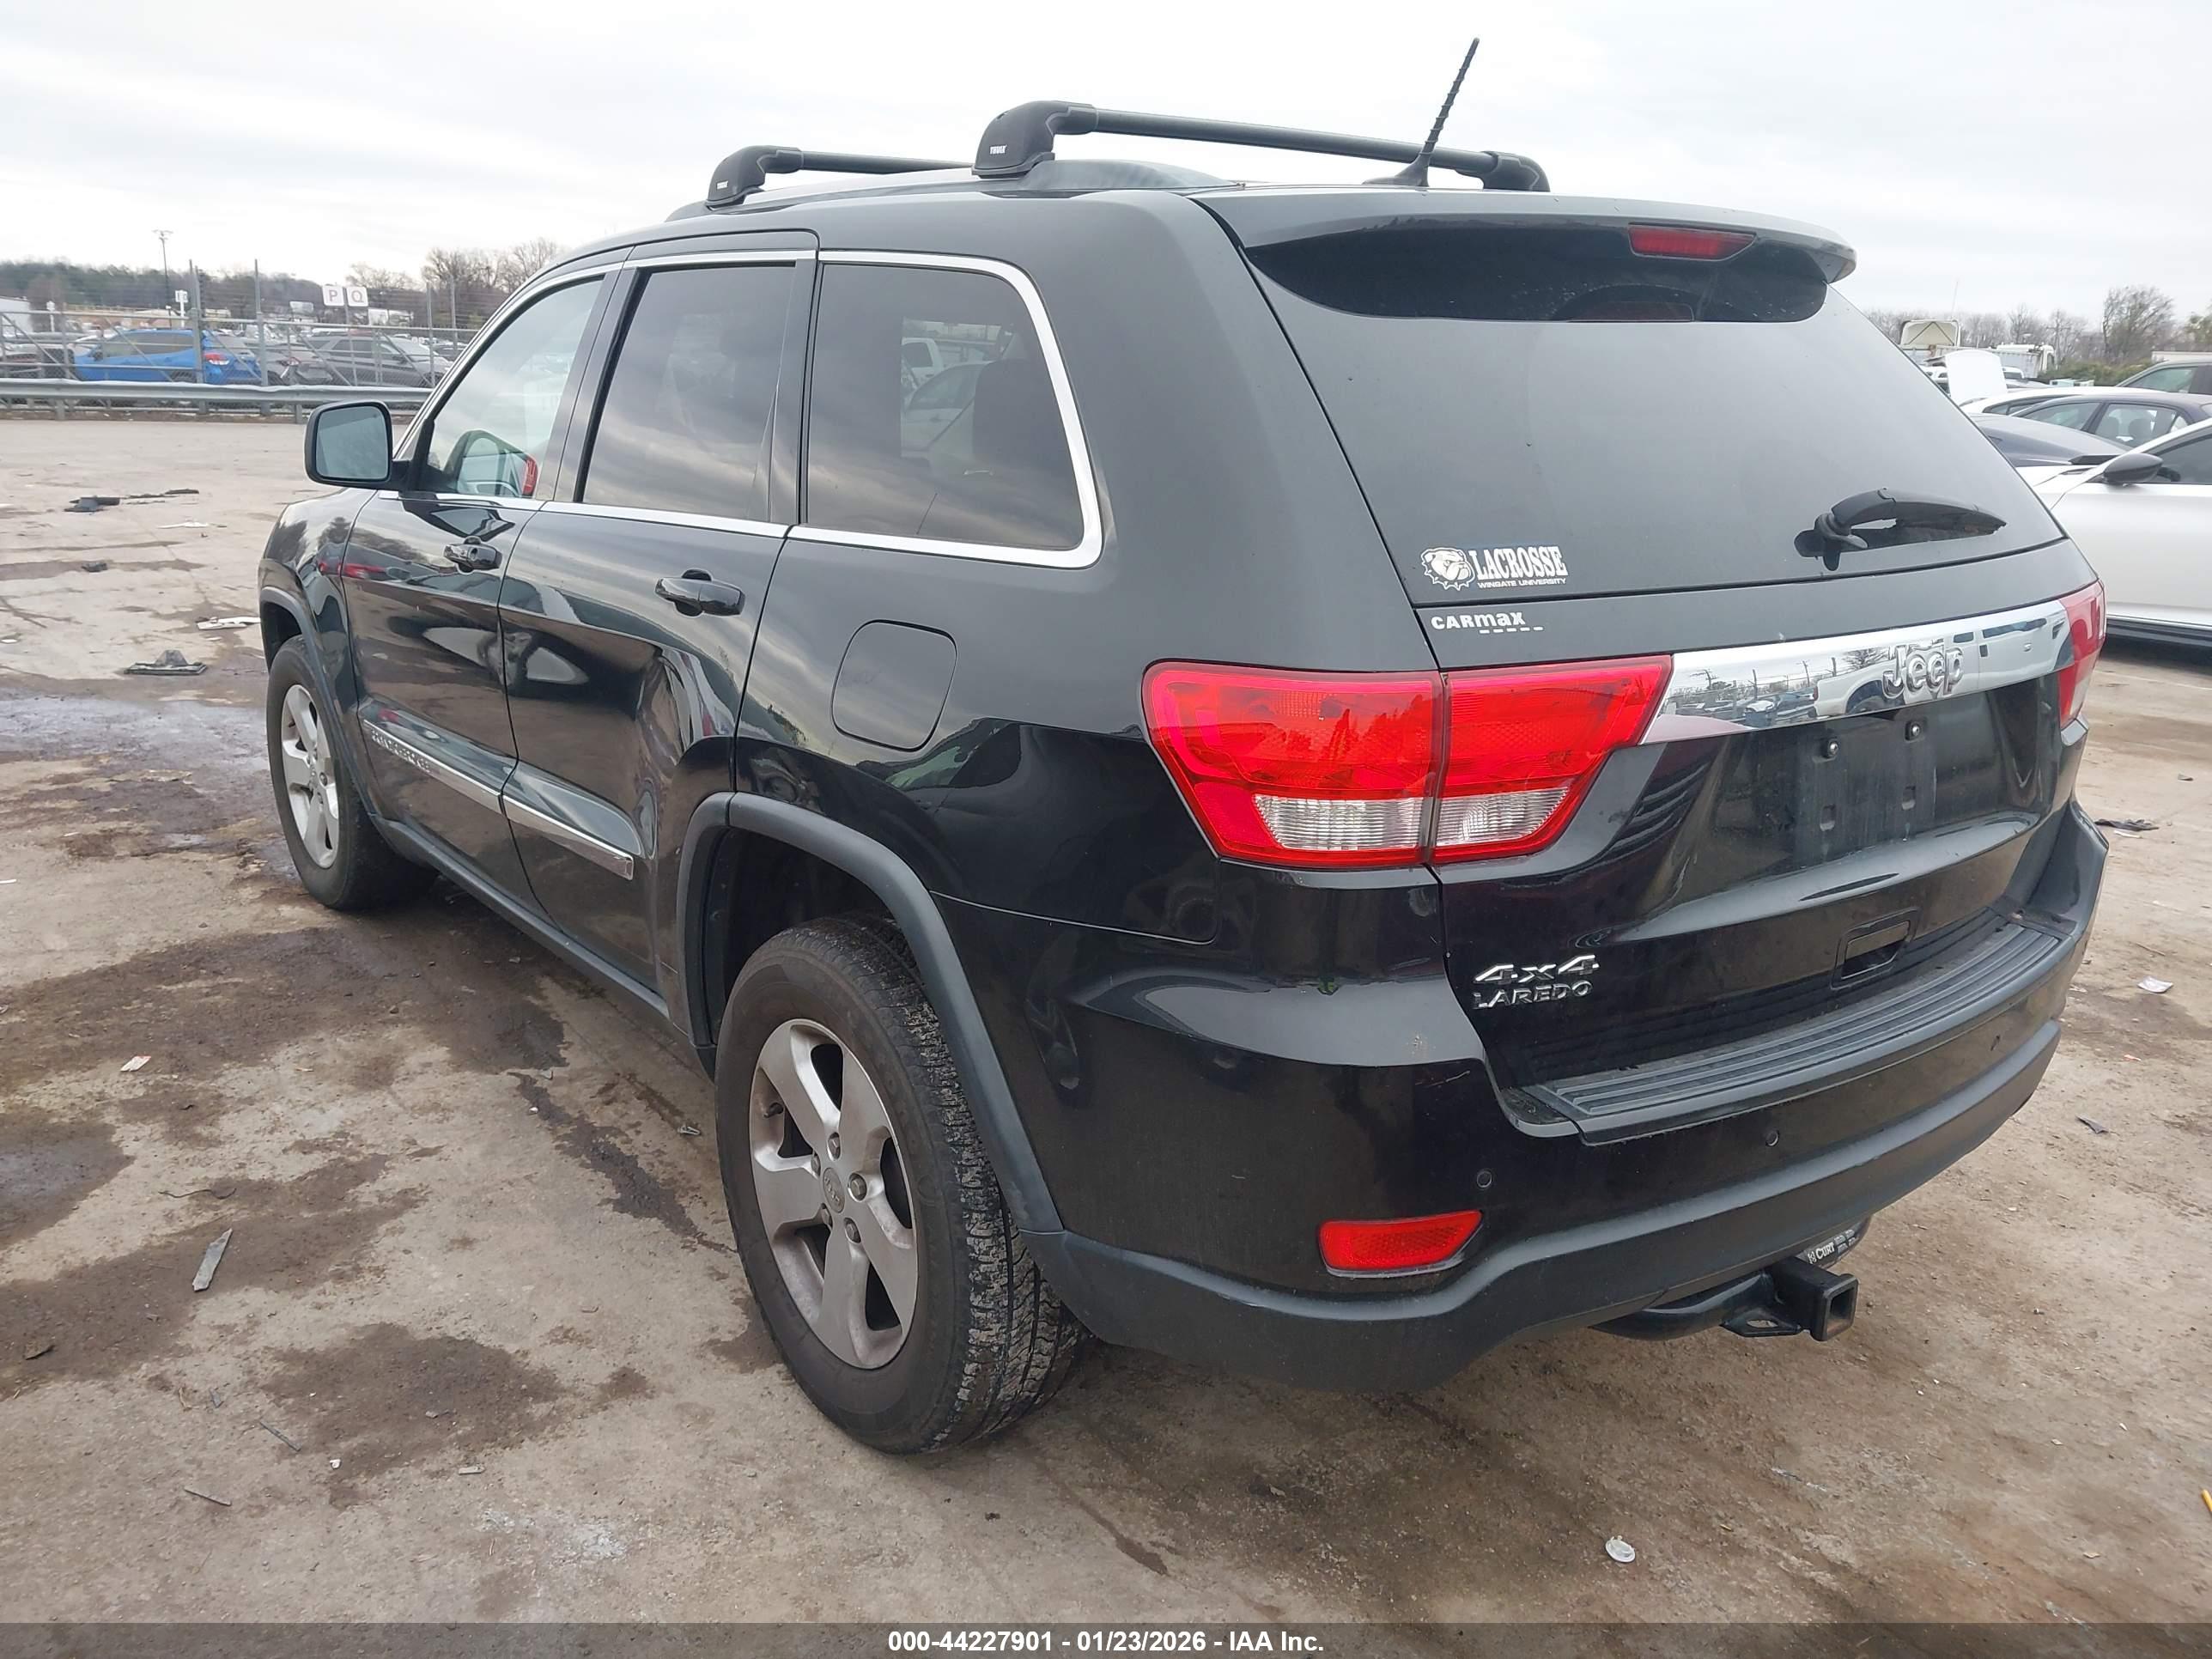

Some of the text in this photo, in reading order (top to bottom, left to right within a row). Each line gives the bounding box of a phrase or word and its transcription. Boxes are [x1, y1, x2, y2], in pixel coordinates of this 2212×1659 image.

[328, 289, 337, 301] P
[351, 290, 364, 302] Q
[1468, 546, 1568, 580] LACROSSE
[1477, 577, 1567, 589] WINGATE UNIVERSITY
[1882, 644, 1964, 699] Jeep
[1473, 980, 1593, 1010] LAREDO
